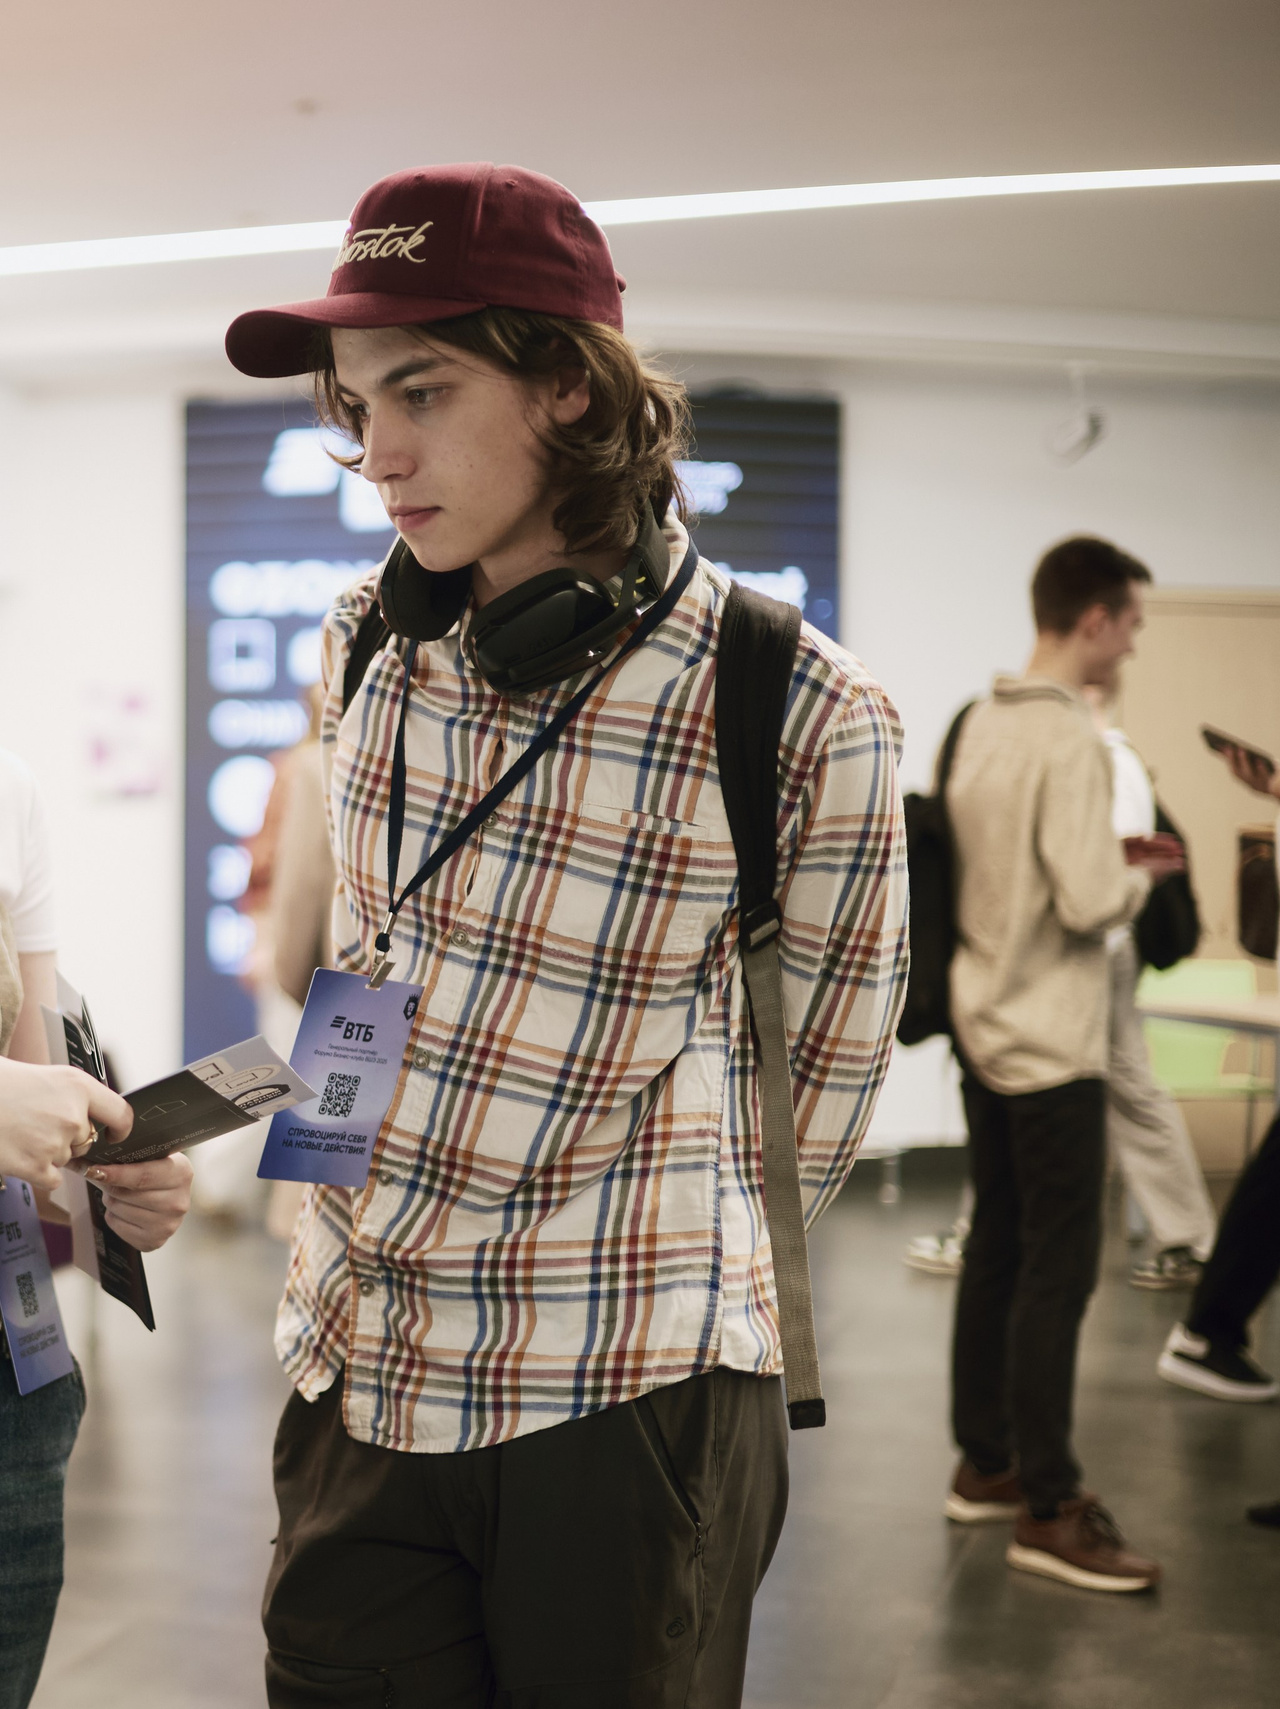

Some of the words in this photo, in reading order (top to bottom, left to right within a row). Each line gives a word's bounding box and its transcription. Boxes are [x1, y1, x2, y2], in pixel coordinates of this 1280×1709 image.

[343, 1021, 375, 1042] ВТБ
[287, 1127, 347, 1141] СПРОВОЦИРУЙ
[347, 1134, 368, 1144] СЕБЯ
[282, 1139, 293, 1148] НА
[294, 1140, 323, 1151] НОВЫЕ
[323, 1142, 367, 1155] ДЕЙСТВИЯ!
[5, 1221, 22, 1242] ВТБ
